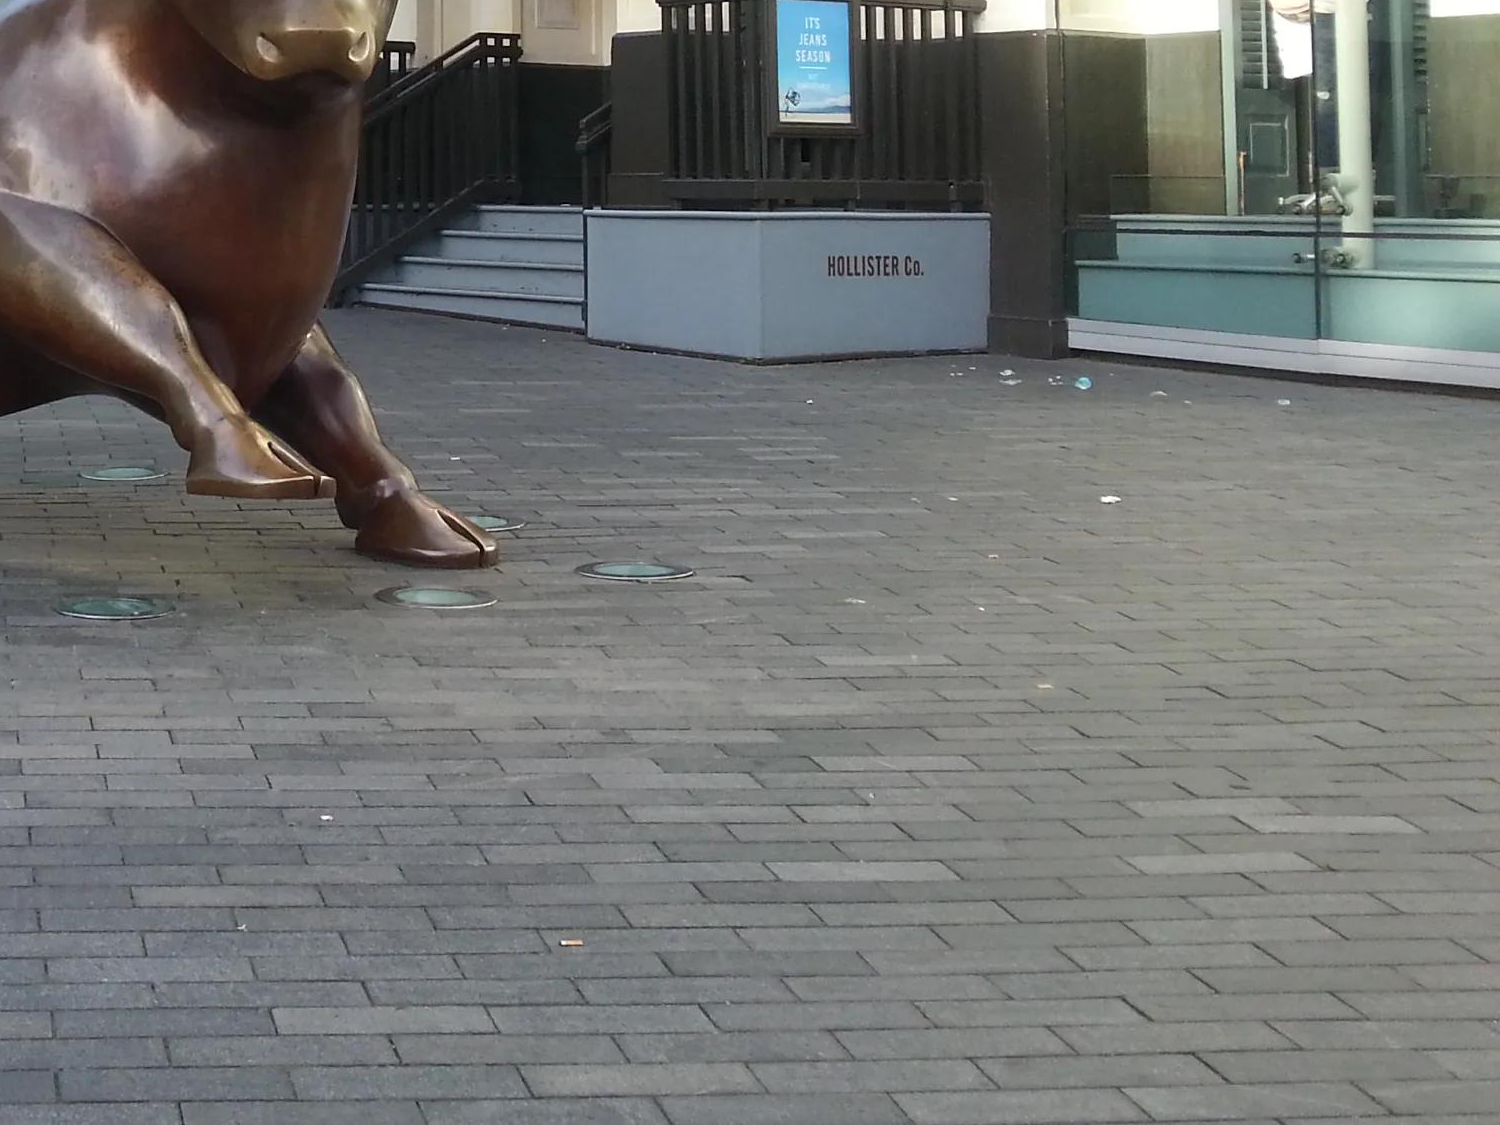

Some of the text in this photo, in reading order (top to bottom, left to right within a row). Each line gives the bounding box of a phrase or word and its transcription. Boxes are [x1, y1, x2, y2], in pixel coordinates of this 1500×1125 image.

[798, 33, 828, 47] JEANS
[795, 49, 831, 63] SEASON
[827, 255, 924, 277] HOLLISTER Co.
